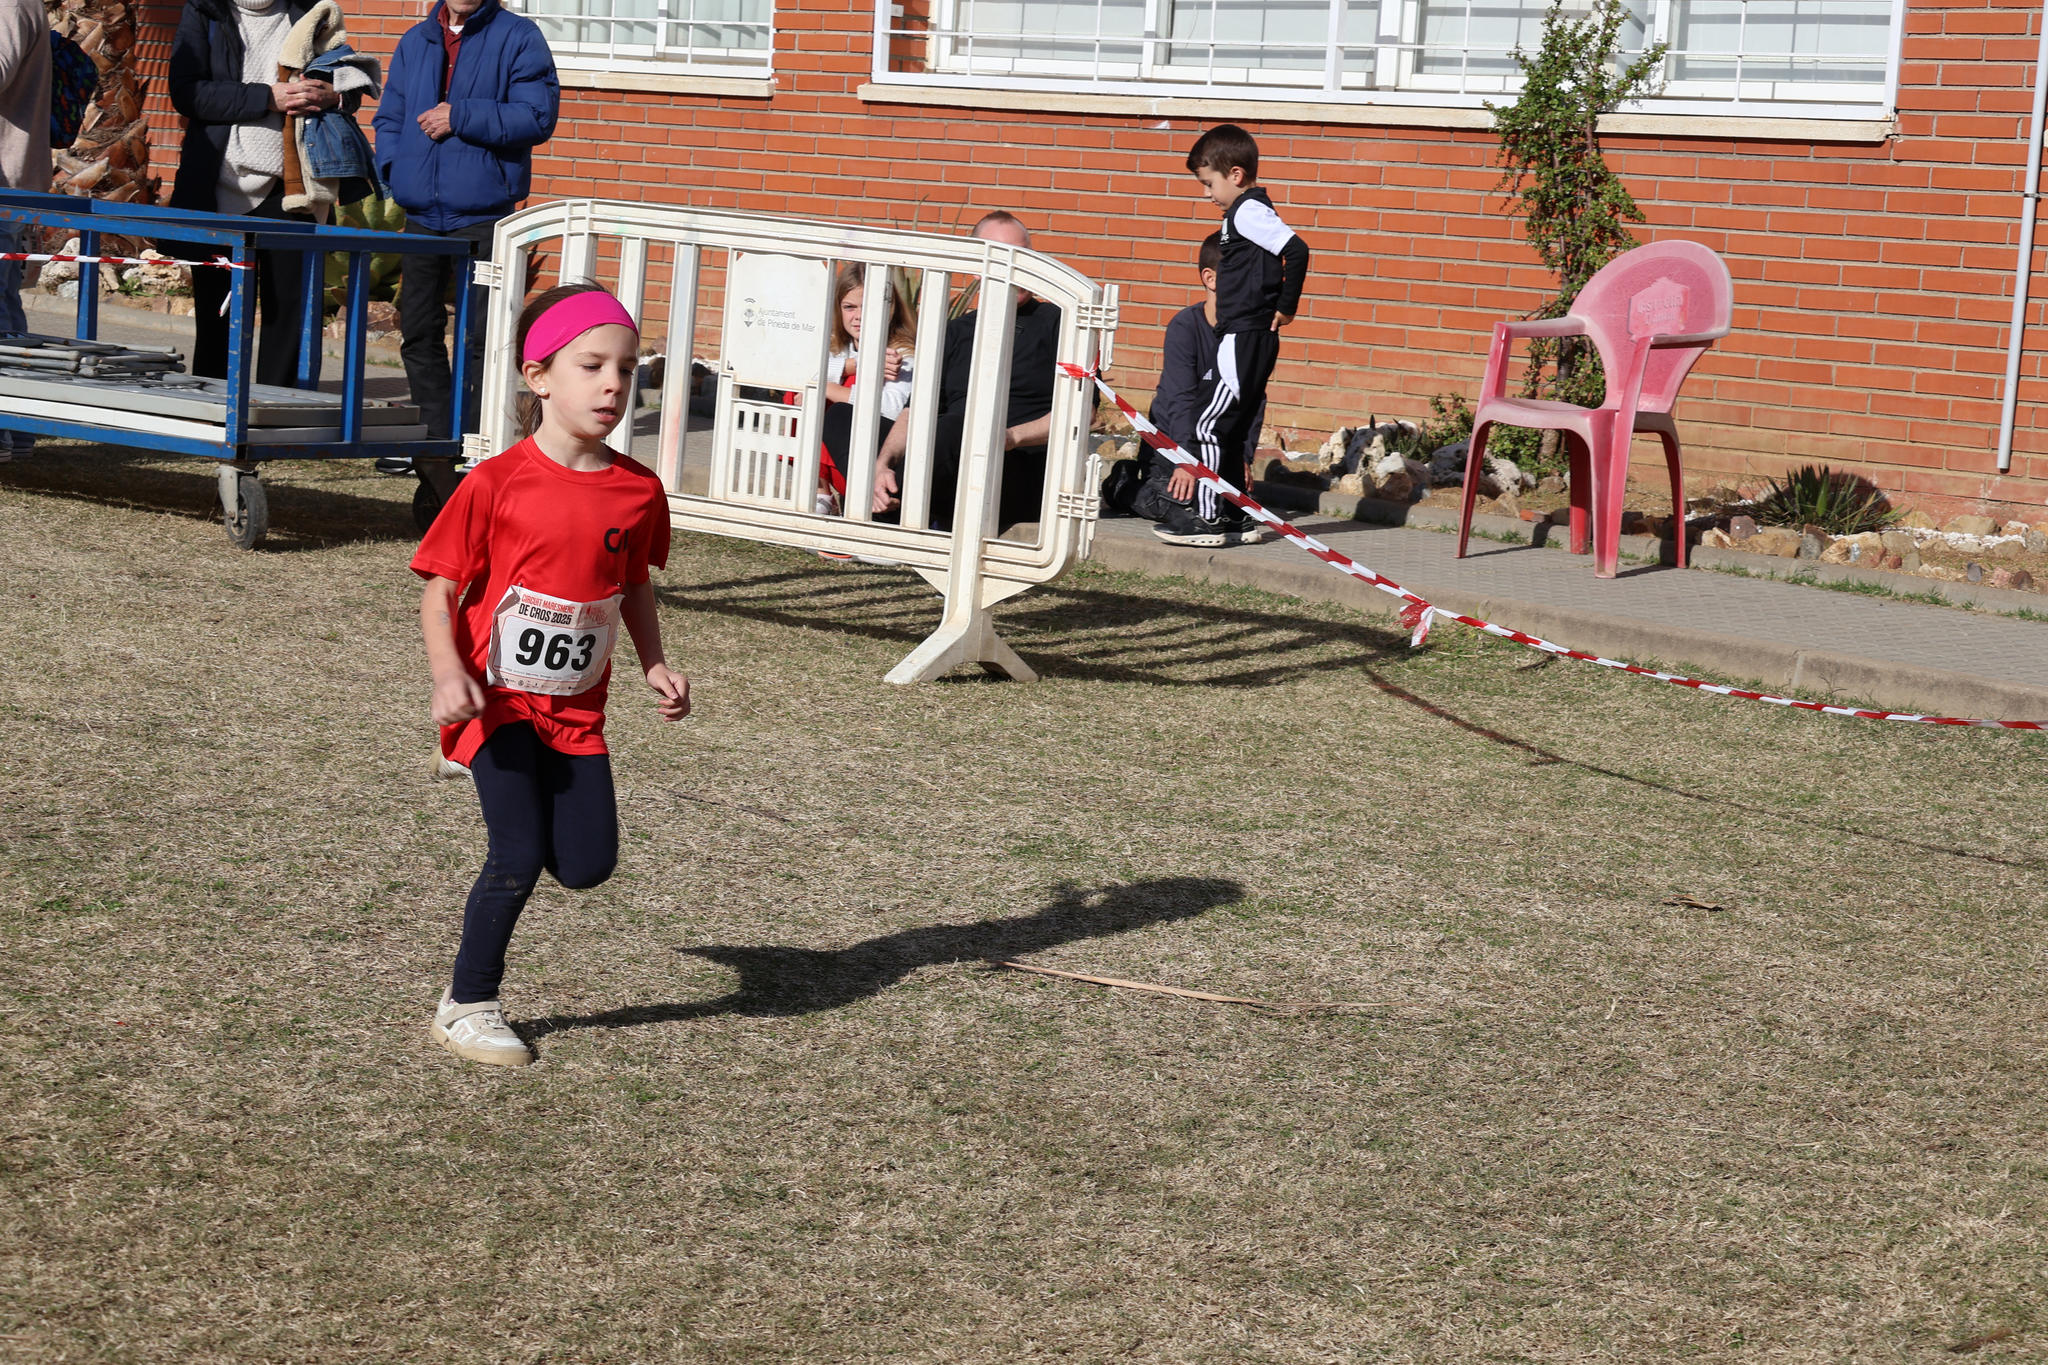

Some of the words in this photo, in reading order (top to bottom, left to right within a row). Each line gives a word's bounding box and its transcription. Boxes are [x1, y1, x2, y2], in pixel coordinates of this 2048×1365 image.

[757, 319, 766, 327] de
[767, 319, 791, 330] Pineda
[791, 323, 801, 331] de
[802, 323, 816, 332] Mar
[521, 593, 543, 608] CIRCUIT
[518, 603, 530, 616] DE
[529, 606, 552, 622] CROS
[551, 612, 573, 625] 2025
[515, 627, 597, 671] 963
